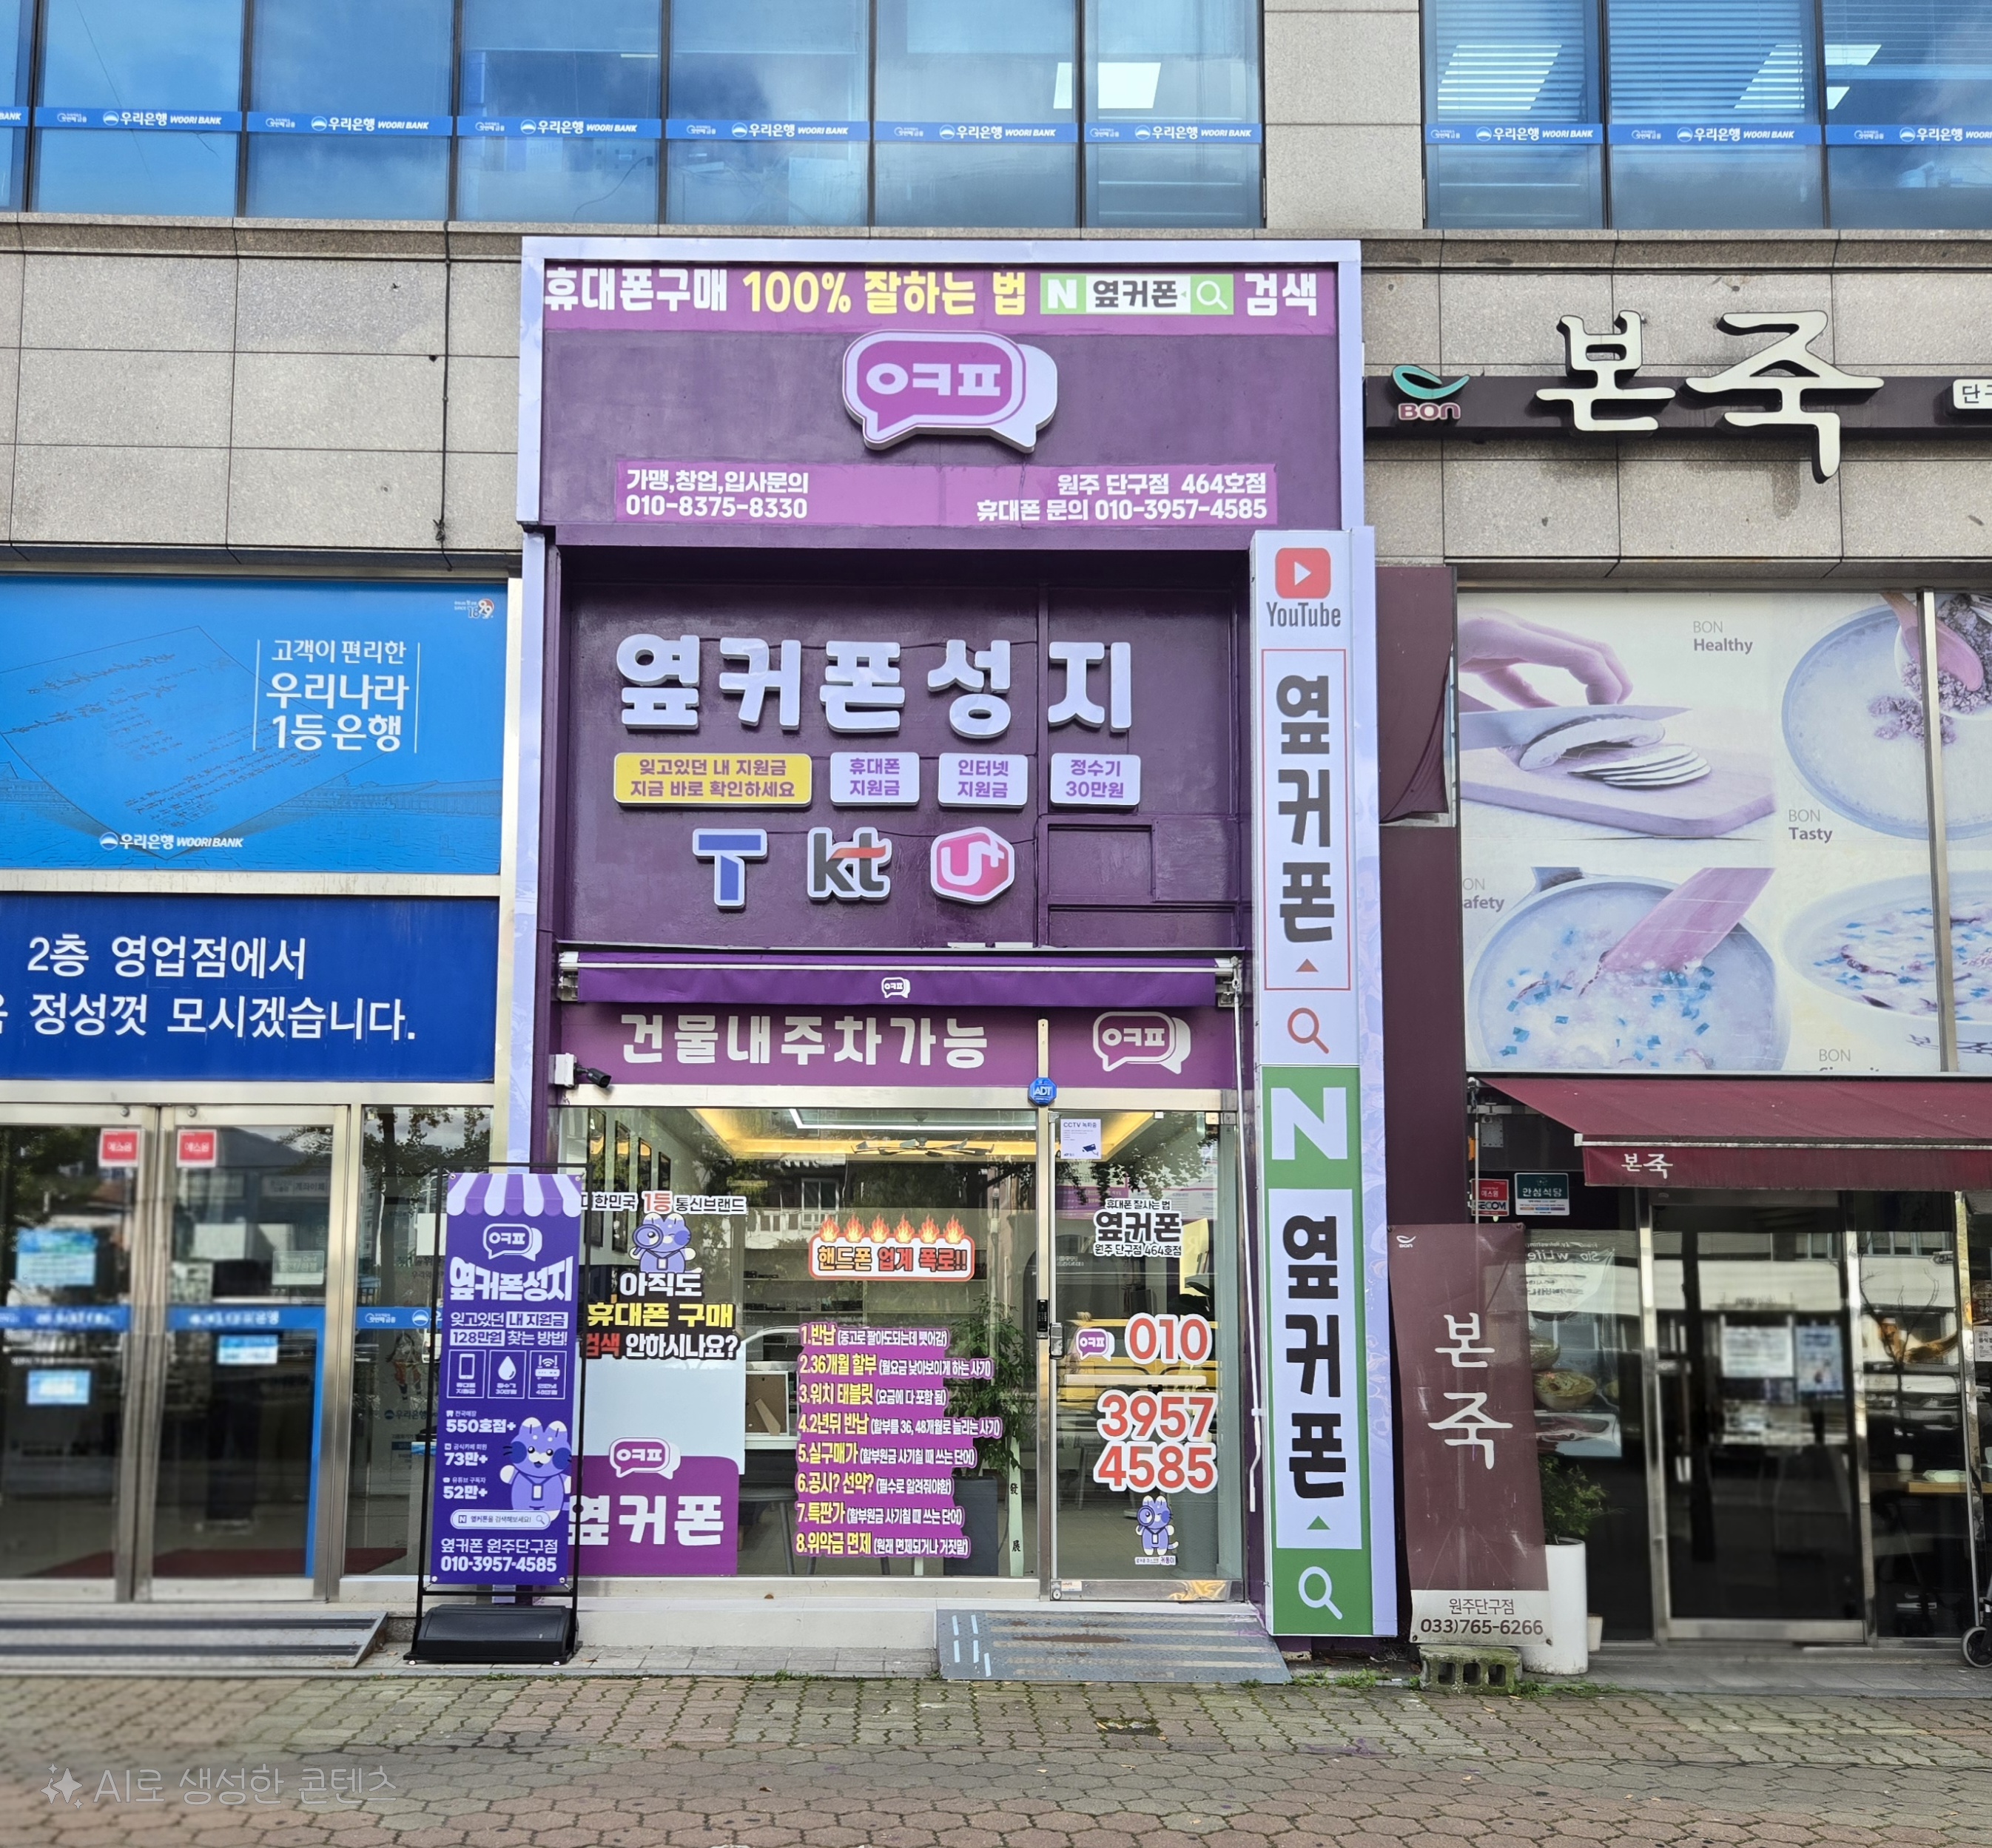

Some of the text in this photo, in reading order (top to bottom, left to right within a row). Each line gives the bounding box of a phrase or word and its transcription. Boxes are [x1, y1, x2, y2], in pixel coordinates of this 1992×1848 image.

[121, 112, 222, 126] 우리은행 WOORI BANK
[328, 117, 429, 132] 우리은행 WOORI BANK
[749, 124, 795, 137] 우리은행
[798, 127, 824, 135] WOORI
[1493, 127, 1593, 141] 우리은행 WOORI BANK
[1694, 127, 1794, 141] 우리은행 WOORI BANK
[1917, 128, 1962, 141] 우리은행
[544, 267, 727, 312] 휴대폰구매
[742, 270, 851, 313] 100%
[864, 270, 975, 315] 잘하는
[993, 272, 1026, 315] 법
[1093, 279, 1179, 308] 옆커폰
[1245, 273, 1316, 317] 검색
[1536, 311, 1884, 479] 본죽
[627, 469, 809, 494] 가맹,창업,입사문의
[1057, 472, 1266, 495] 원주 단구점 464호점
[626, 495, 808, 519] 010-8375-8330
[977, 499, 1267, 522] 휴대폰 문의 010-3957-4585
[1266, 602, 1341, 628] YouTube
[1692, 621, 1723, 633] BON
[272, 640, 406, 664] 고객이 편리한
[1693, 638, 1754, 655] Healthy
[266, 672, 409, 710] 우리나라
[639, 759, 787, 776] 잊고있던 내 지원금
[849, 758, 901, 775] 휴대폰
[958, 760, 1009, 777] 인터넷
[1070, 760, 1121, 777] 정수기
[630, 780, 795, 797] 지금 바로 확인하세요
[849, 780, 901, 796] 지원금
[958, 781, 1009, 798] 지원금
[1066, 781, 1124, 798] 30만원
[1276, 675, 1335, 942] 옆커폰
[1789, 809, 1821, 823] BON
[120, 834, 243, 850] 우리은행 WOORI BANK
[1789, 826, 1833, 843] Tasty
[27, 934, 307, 979] 2층 영업점에서
[30, 992, 148, 1036] 정성껏
[167, 995, 415, 1040] 모시겠습니다.
[1819, 1048, 1851, 1062] BON
[1033, 1086, 1052, 1095] ADT
[1272, 1087, 1347, 1160] N
[1621, 1153, 1673, 1179] 본죽
[1523, 1187, 1562, 1197] 안심식당
[644, 1193, 671, 1212] 1등
[676, 1196, 745, 1212] 통신브랜드
[1106, 1199, 1171, 1210] 휴대폰 잘사는 법
[1096, 1212, 1182, 1242] 옆커폰
[818, 1245, 872, 1271] 핸드폰
[1095, 1245, 1182, 1255] 원주 단구점 464호점
[450, 1256, 573, 1301] 옆커폰성지
[620, 1272, 703, 1297] 아직도
[451, 1312, 504, 1327] 잊고있던
[509, 1313, 523, 1326] 내
[526, 1313, 565, 1326] 지원금
[588, 1302, 733, 1327] 휴대폰 구매
[453, 1330, 568, 1346] 128만원 찾는 방법!
[801, 1324, 836, 1346] 1.반납
[1129, 1318, 1208, 1360] 010
[586, 1332, 738, 1358] 검색 안하시나요?
[852, 1354, 877, 1375] 할부
[952, 1360, 969, 1376] 하는
[1282, 1215, 1347, 1499] 옆커폰
[799, 1383, 834, 1404] 3.워치
[837, 1383, 873, 1405] 태블릿
[906, 1389, 915, 1405] 다
[916, 1389, 934, 1405] 포함
[844, 1412, 869, 1434] 반납
[1102, 1394, 1214, 1437] 3957
[445, 1418, 516, 1434] 550호점+
[445, 1452, 488, 1466] 73만+
[1098, 1445, 1214, 1488] 4585
[443, 1485, 488, 1499] 52만+
[569, 1494, 724, 1546] 옆커폰
[441, 1539, 558, 1554] 옆커폰 원주단구점
[796, 1532, 844, 1554] 8.위약금
[847, 1532, 872, 1554] 면제
[441, 1557, 557, 1574] 010-3957-4585
[1448, 1598, 1515, 1616] 원주단구점
[1421, 1619, 1544, 1635] 033)765-6266
